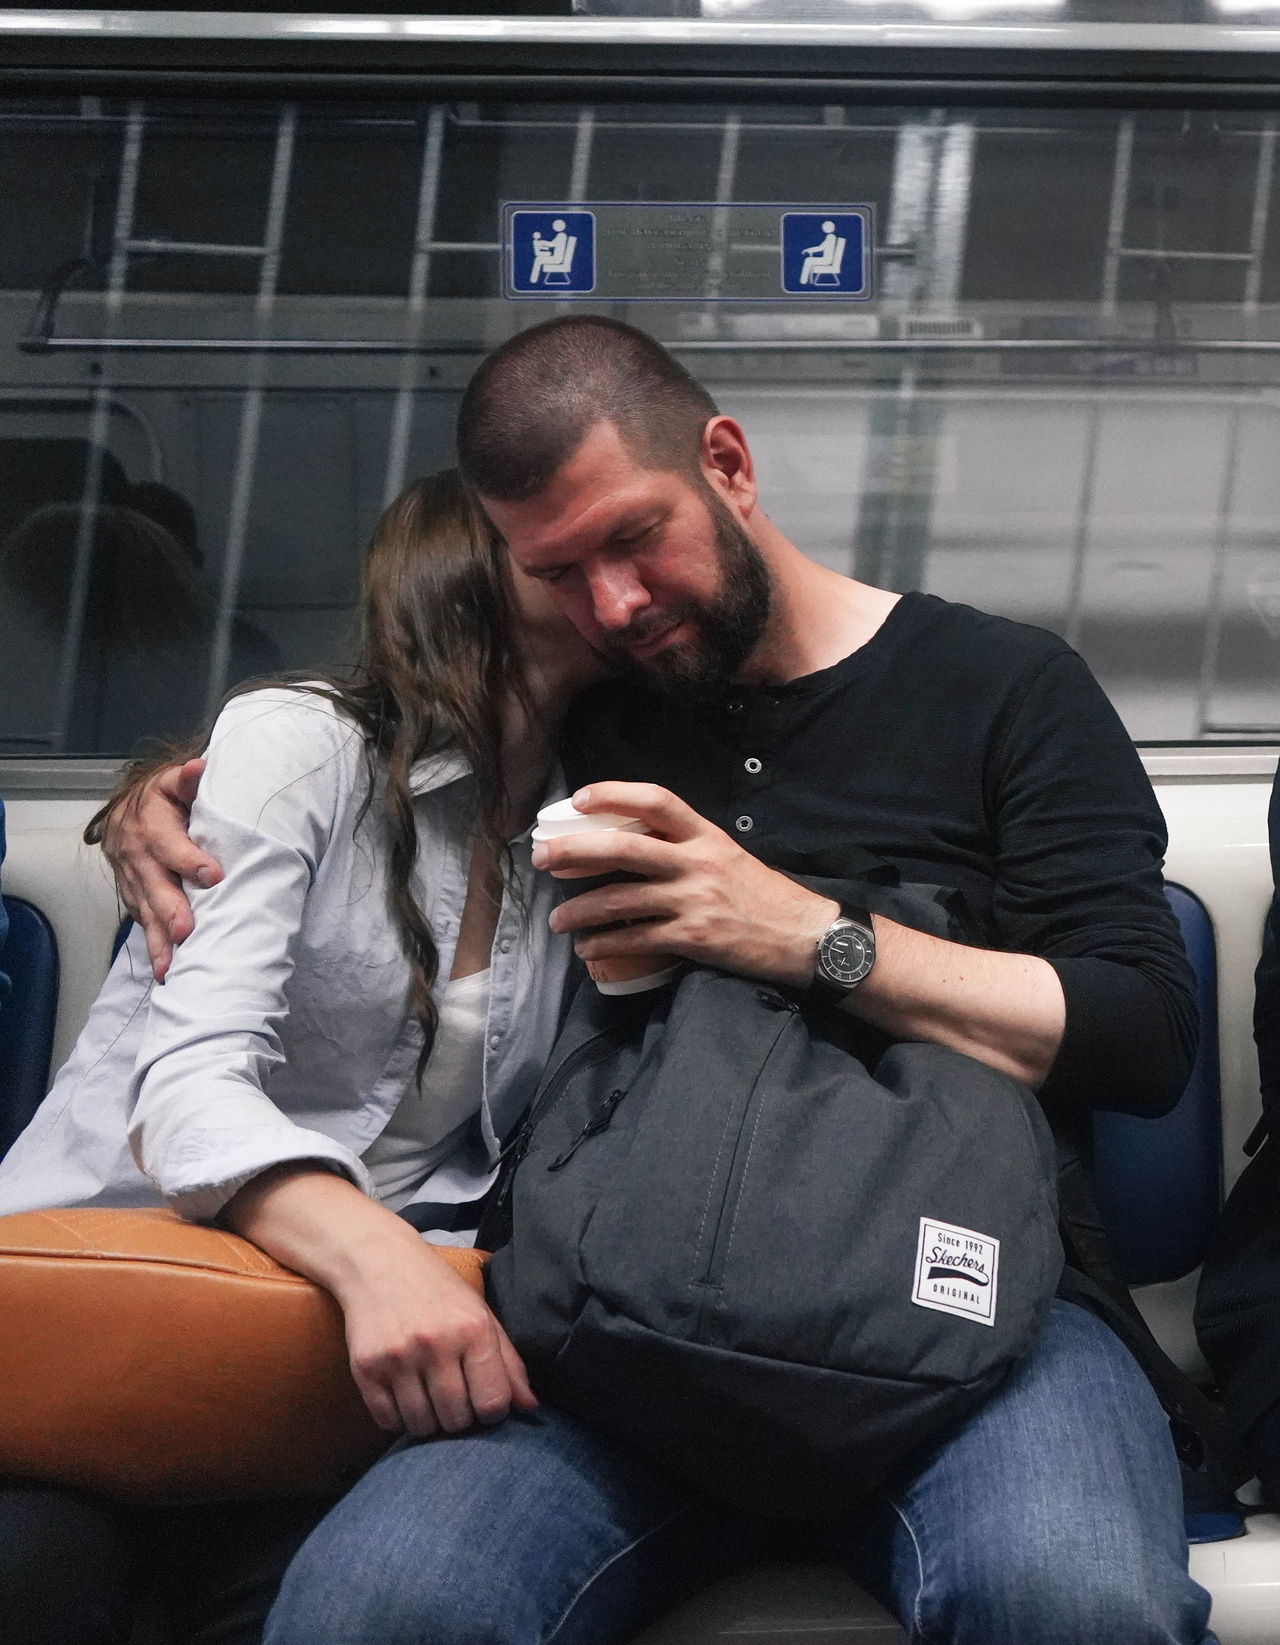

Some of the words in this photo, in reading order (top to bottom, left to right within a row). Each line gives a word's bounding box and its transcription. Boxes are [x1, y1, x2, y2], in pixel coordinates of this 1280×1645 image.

[938, 1232, 960, 1247] Since
[965, 1240, 983, 1254] 1992
[925, 1246, 985, 1273] Skechers
[933, 1284, 980, 1304] ORIGINAL
